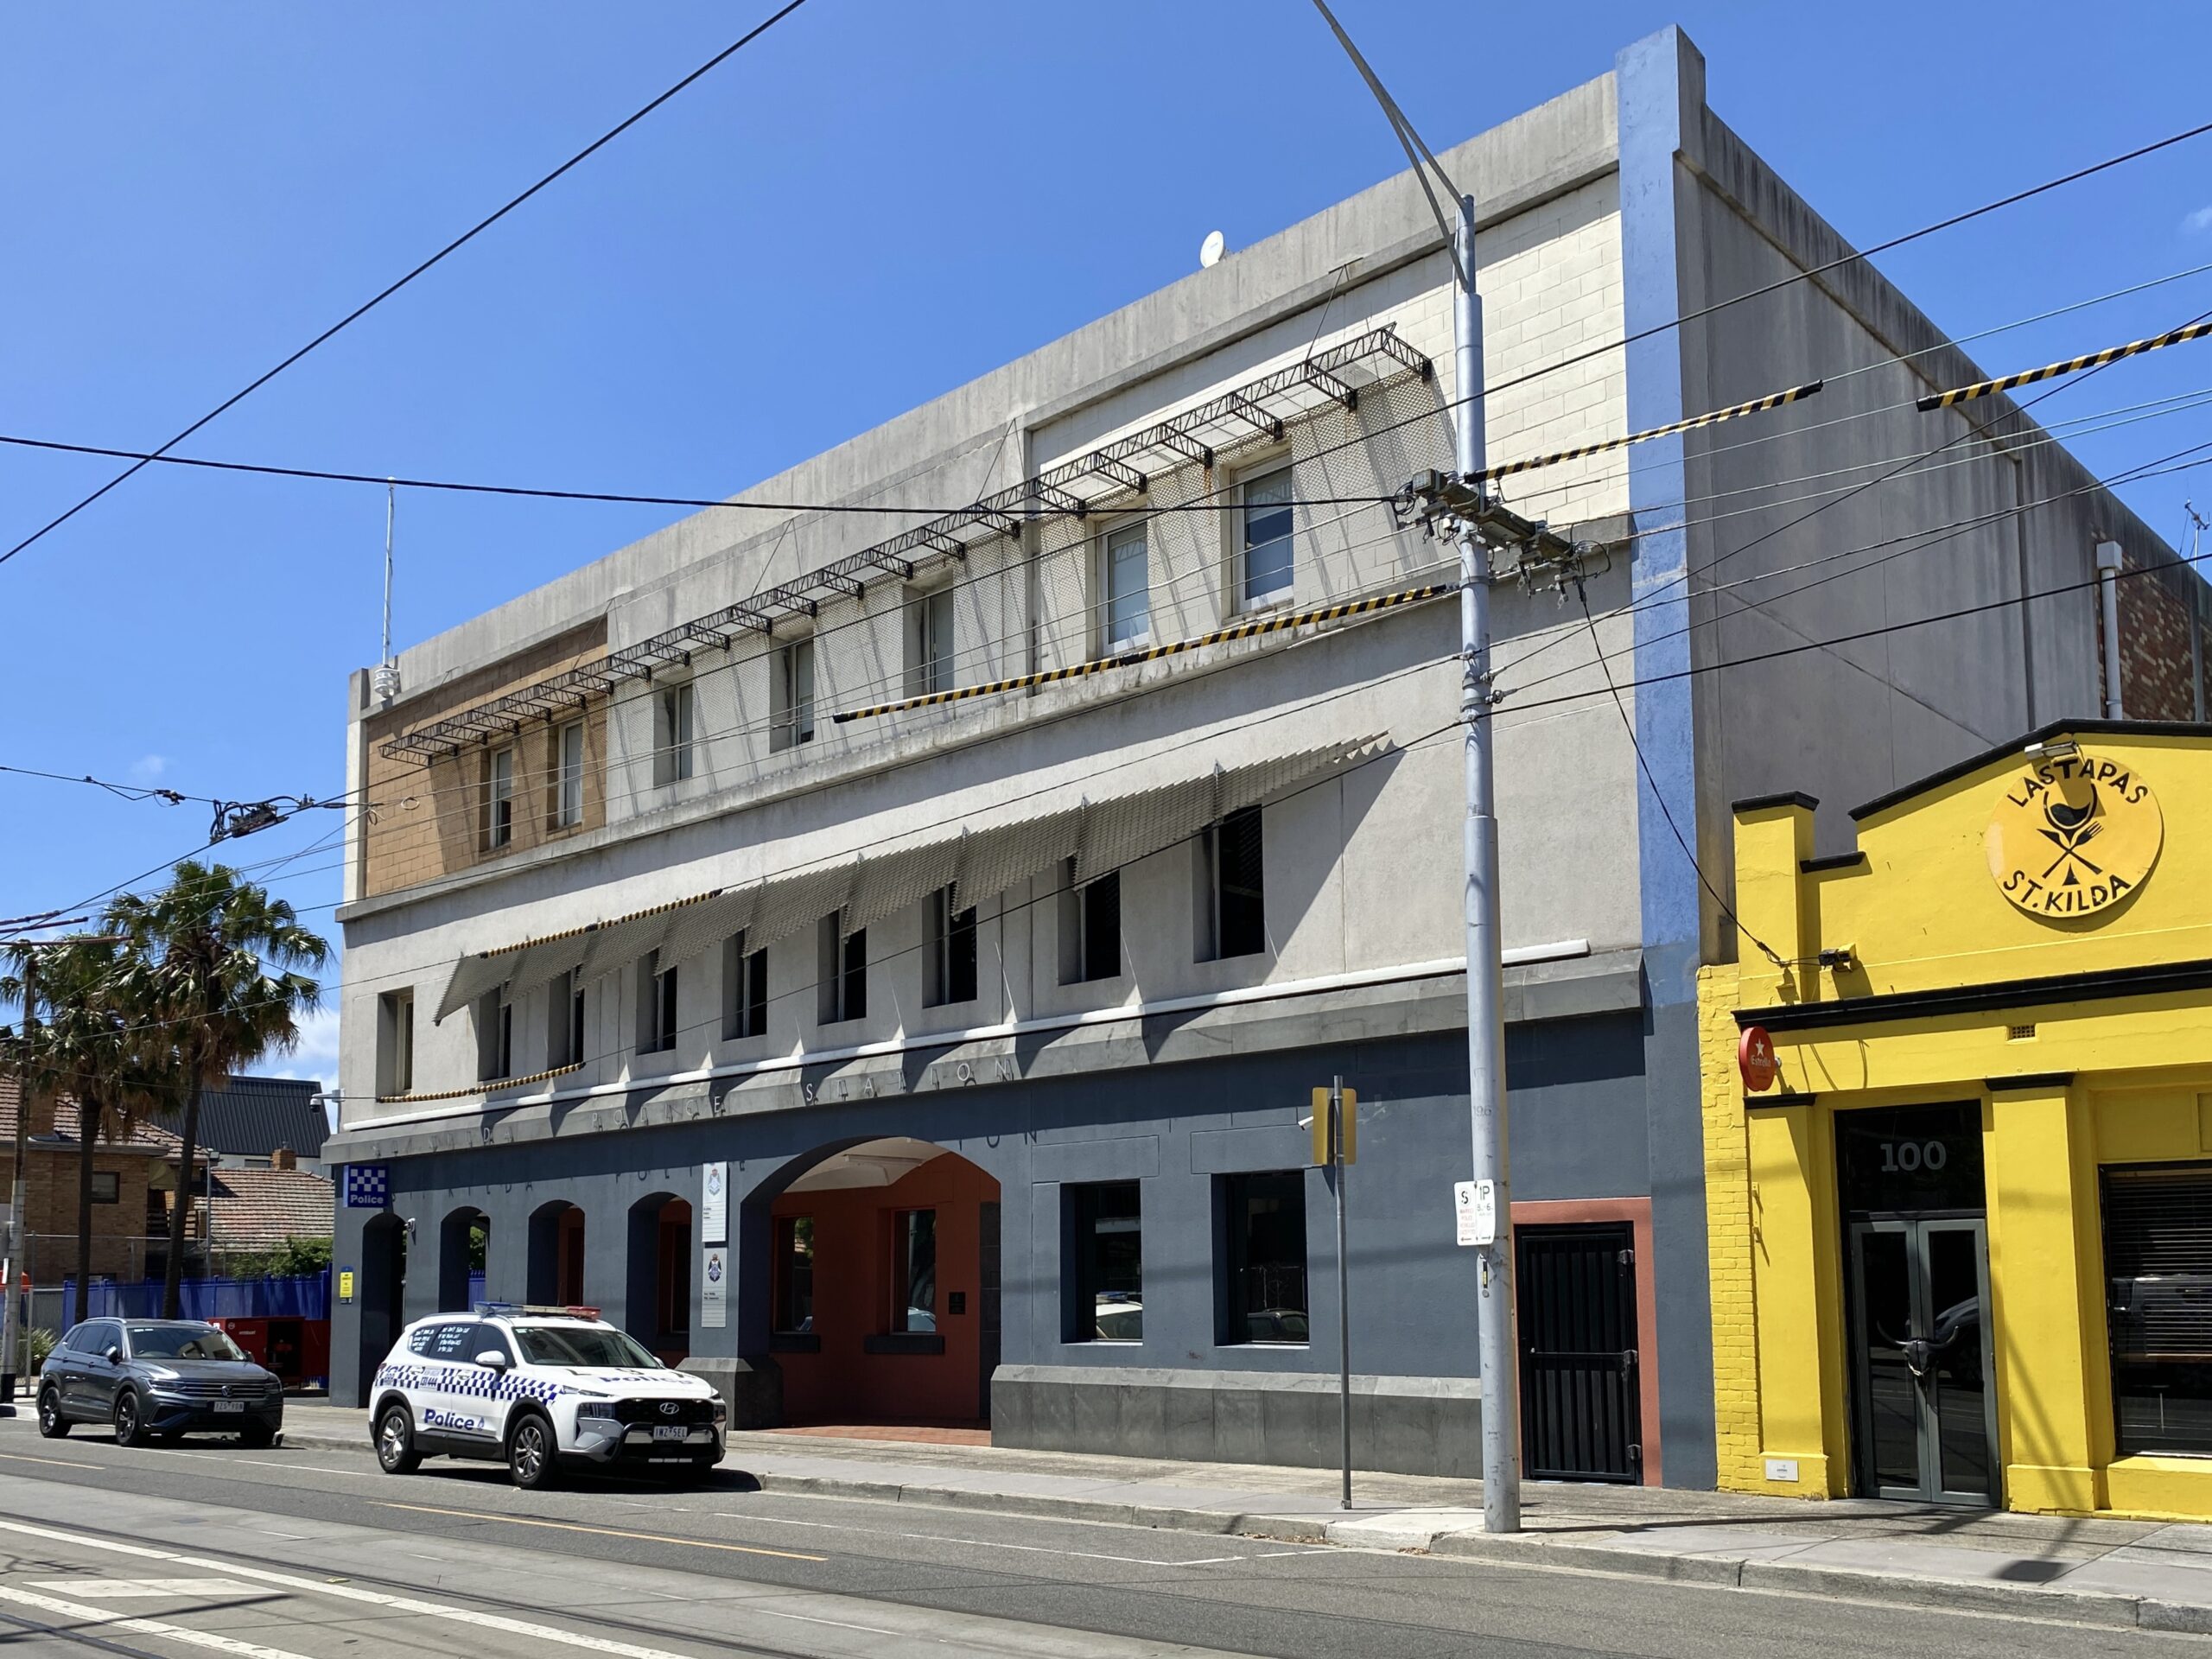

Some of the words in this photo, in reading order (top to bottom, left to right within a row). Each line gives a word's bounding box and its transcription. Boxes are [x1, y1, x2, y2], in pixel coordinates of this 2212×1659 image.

[1880, 1141, 1947, 1172] 100
[350, 1194, 384, 1204] Police
[423, 1408, 474, 1431] Police
